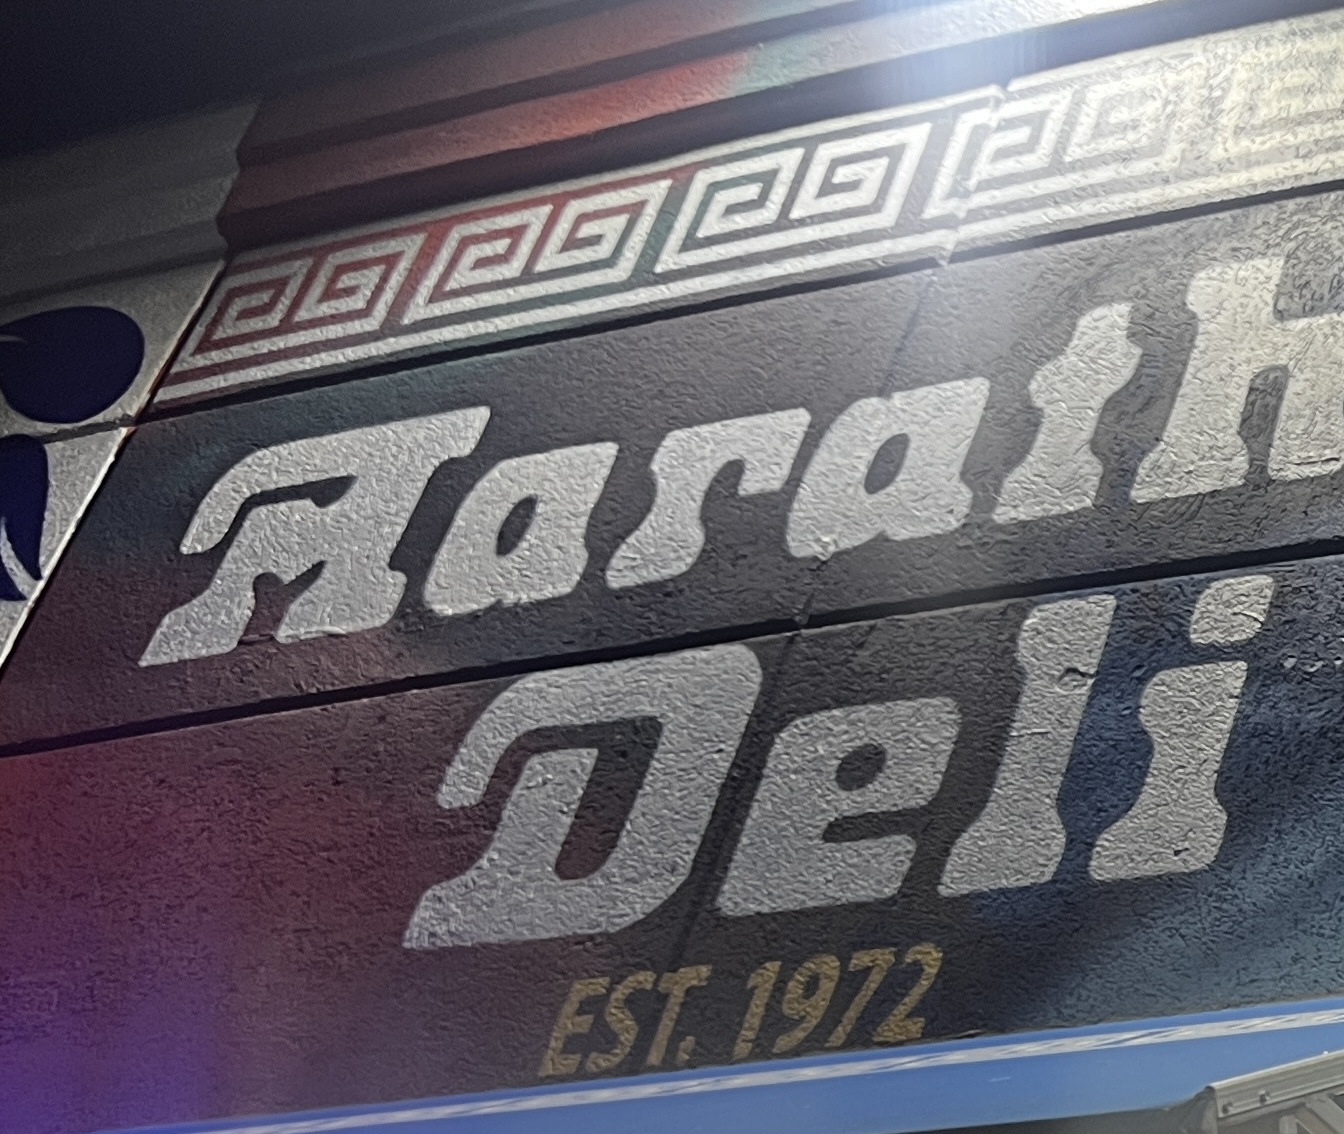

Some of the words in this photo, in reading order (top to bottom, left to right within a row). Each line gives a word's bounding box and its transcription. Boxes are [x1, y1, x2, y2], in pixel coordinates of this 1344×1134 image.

[403, 573, 1276, 949] Deli
[537, 962, 709, 1078] EST.
[731, 940, 944, 1064] 1972
